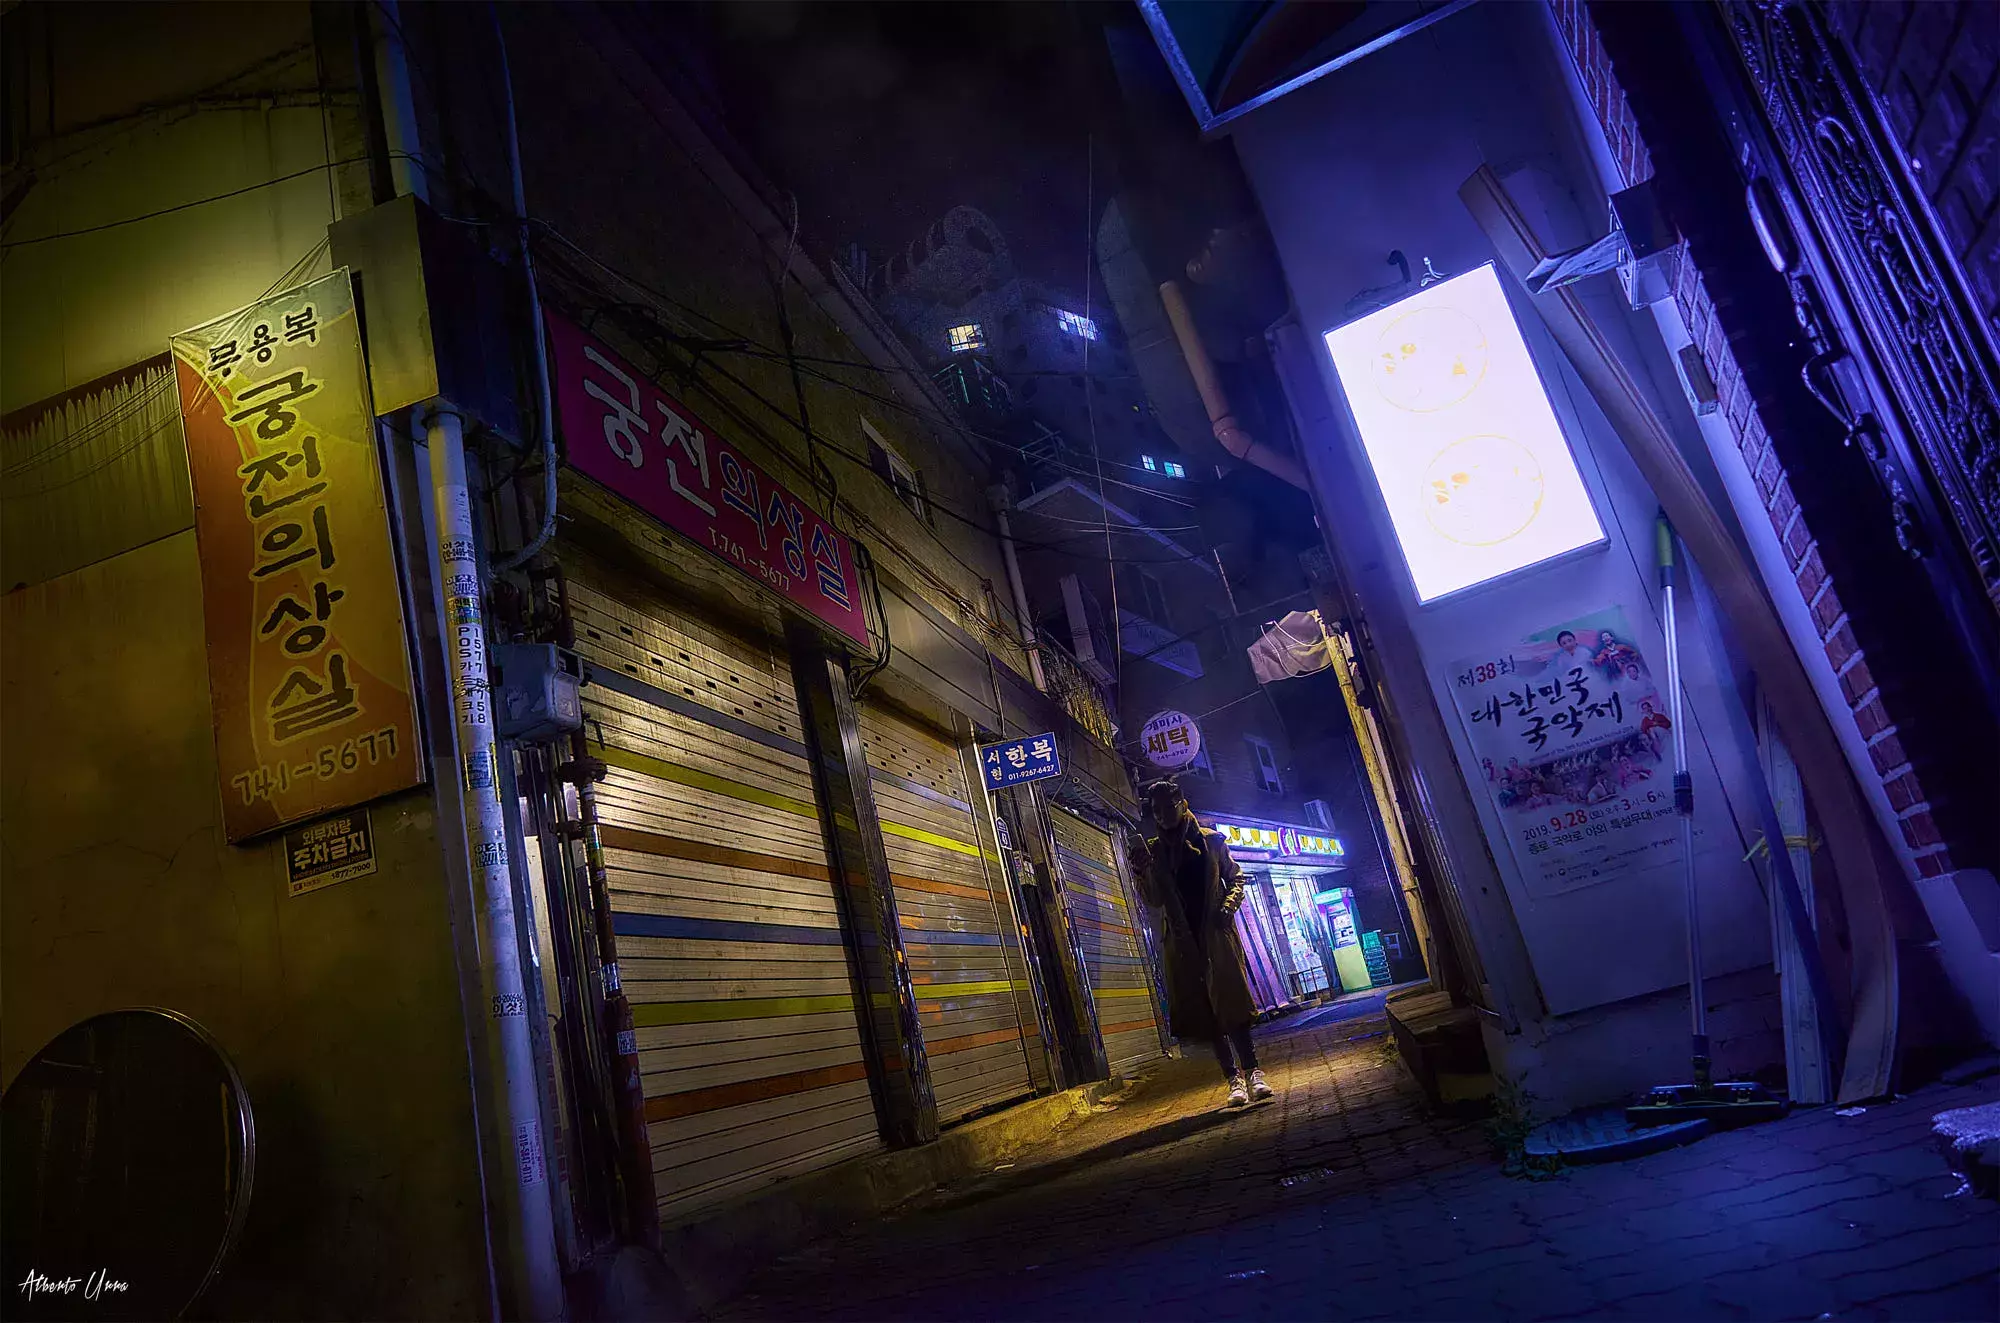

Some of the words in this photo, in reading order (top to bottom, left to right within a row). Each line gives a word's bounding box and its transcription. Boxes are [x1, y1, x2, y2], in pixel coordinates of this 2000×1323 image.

[208, 306, 319, 377] 무용복
[229, 371, 361, 741] 궁전의상실
[1458, 654, 1516, 688] 제38회
[1471, 667, 1590, 727] 대한민국
[1147, 725, 1190, 754] 세탁
[1521, 691, 1623, 751] 국악제
[233, 728, 396, 799] 741-5677
[1005, 739, 1053, 768] 한복
[293, 830, 366, 870] 주차금지
